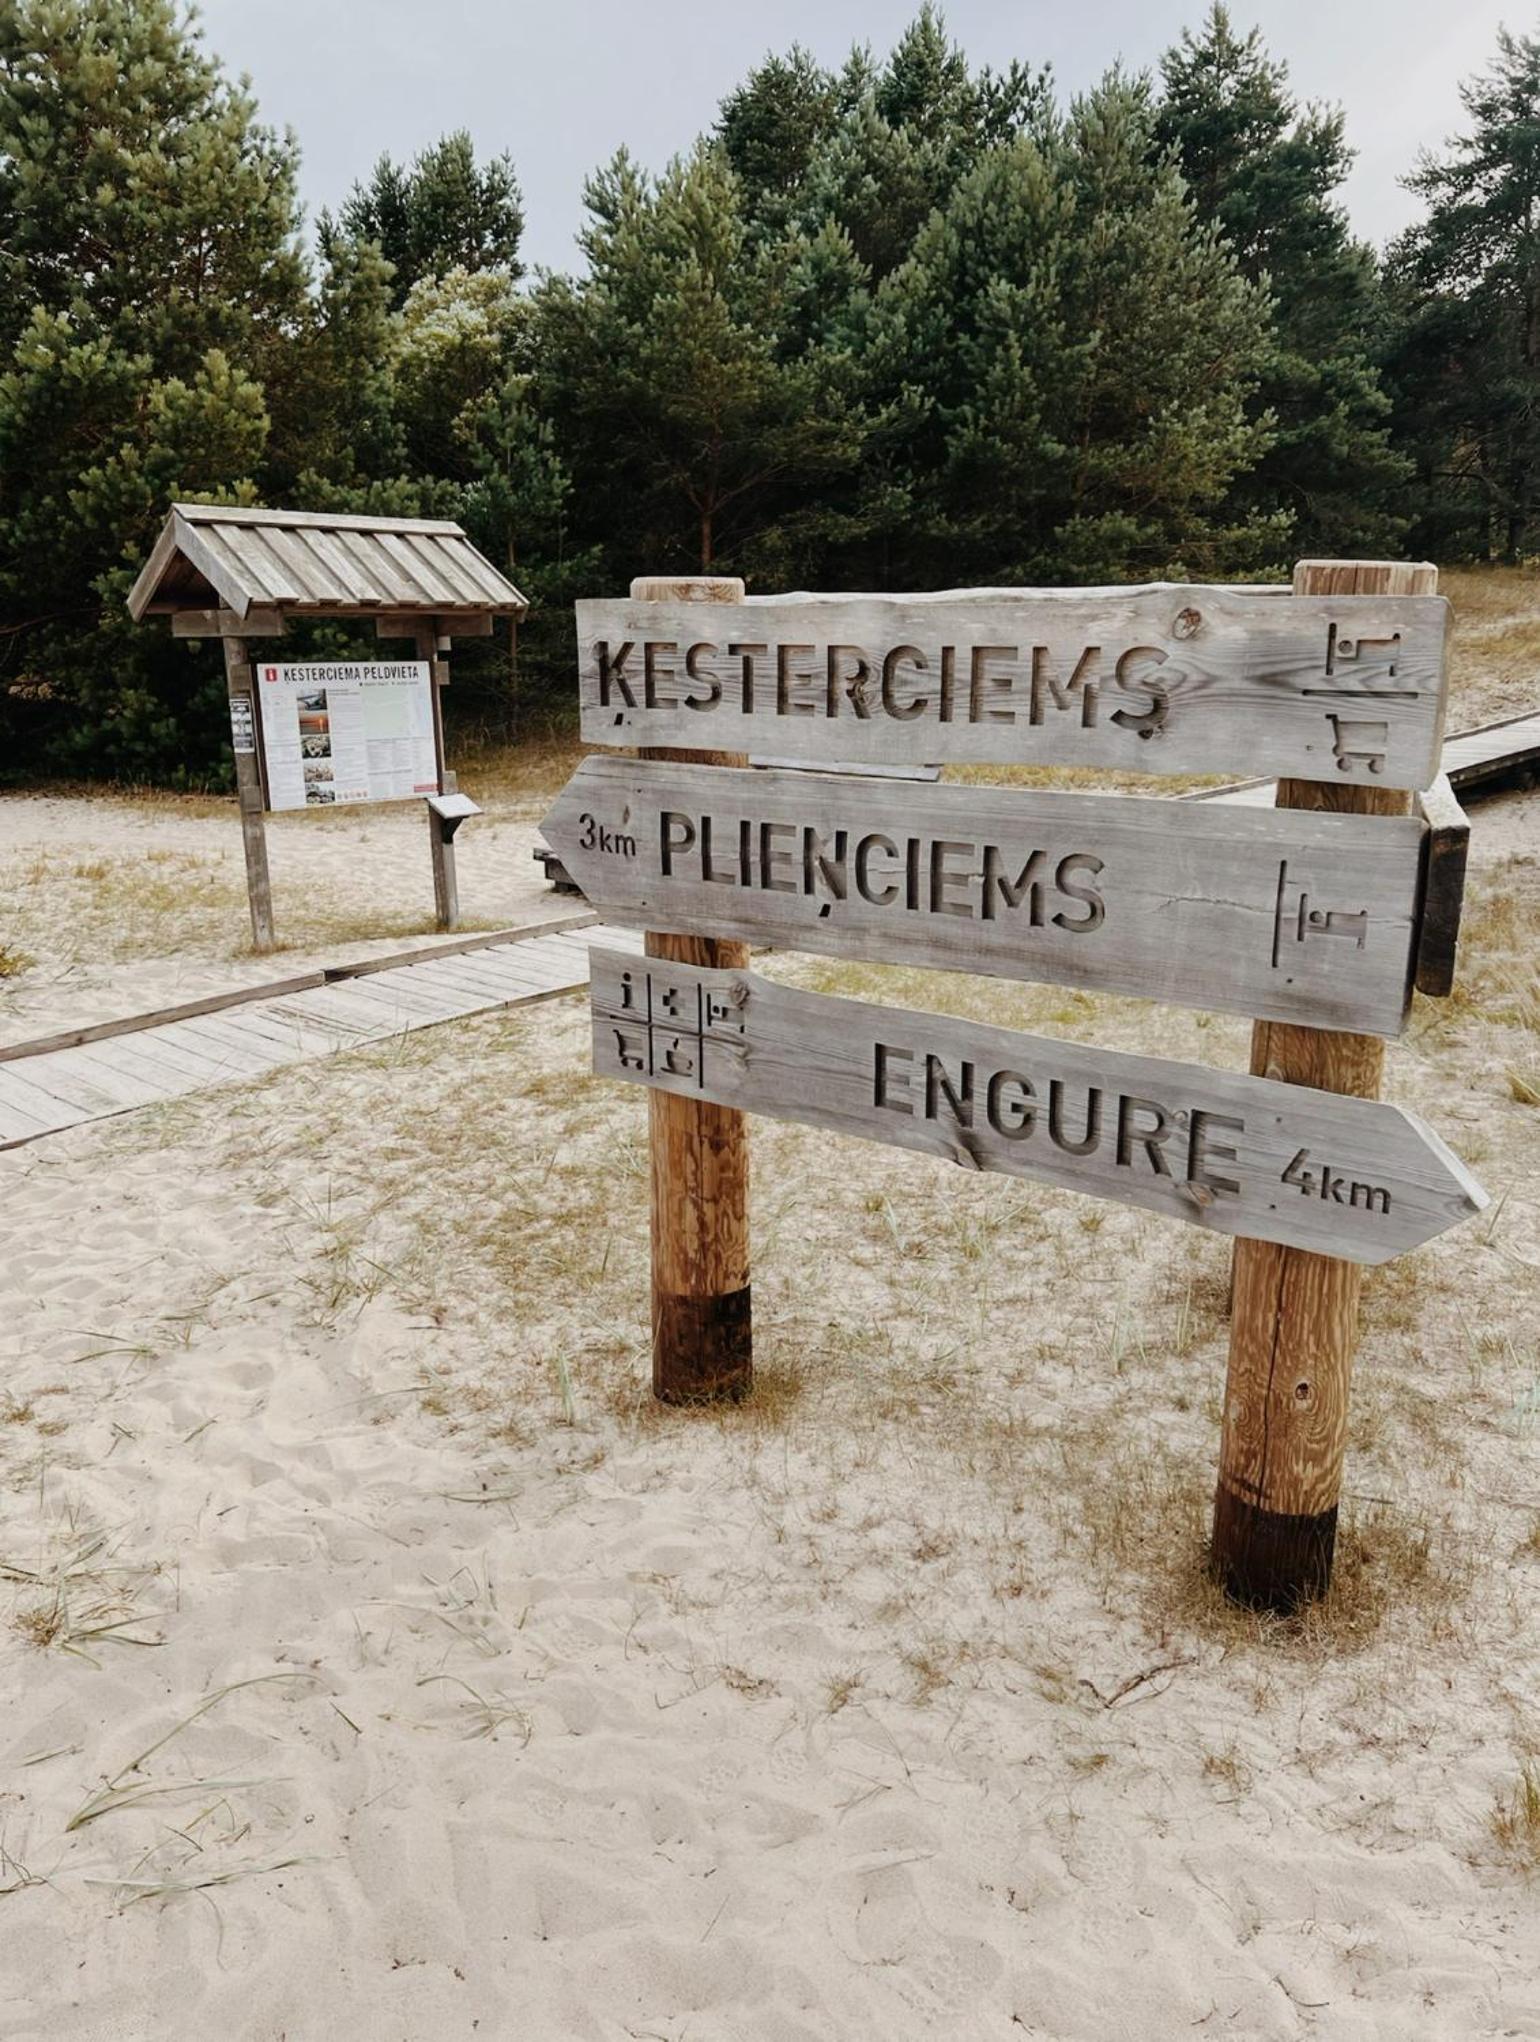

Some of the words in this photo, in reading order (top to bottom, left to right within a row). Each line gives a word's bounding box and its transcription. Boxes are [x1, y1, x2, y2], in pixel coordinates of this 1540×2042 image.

[364, 665, 419, 680] PELDVIETA
[579, 812, 637, 858] 3km
[659, 810, 1106, 934] PLIEŅCIEMS
[874, 1042, 1245, 1194] ENGURE
[1280, 1148, 1393, 1215] 4km
